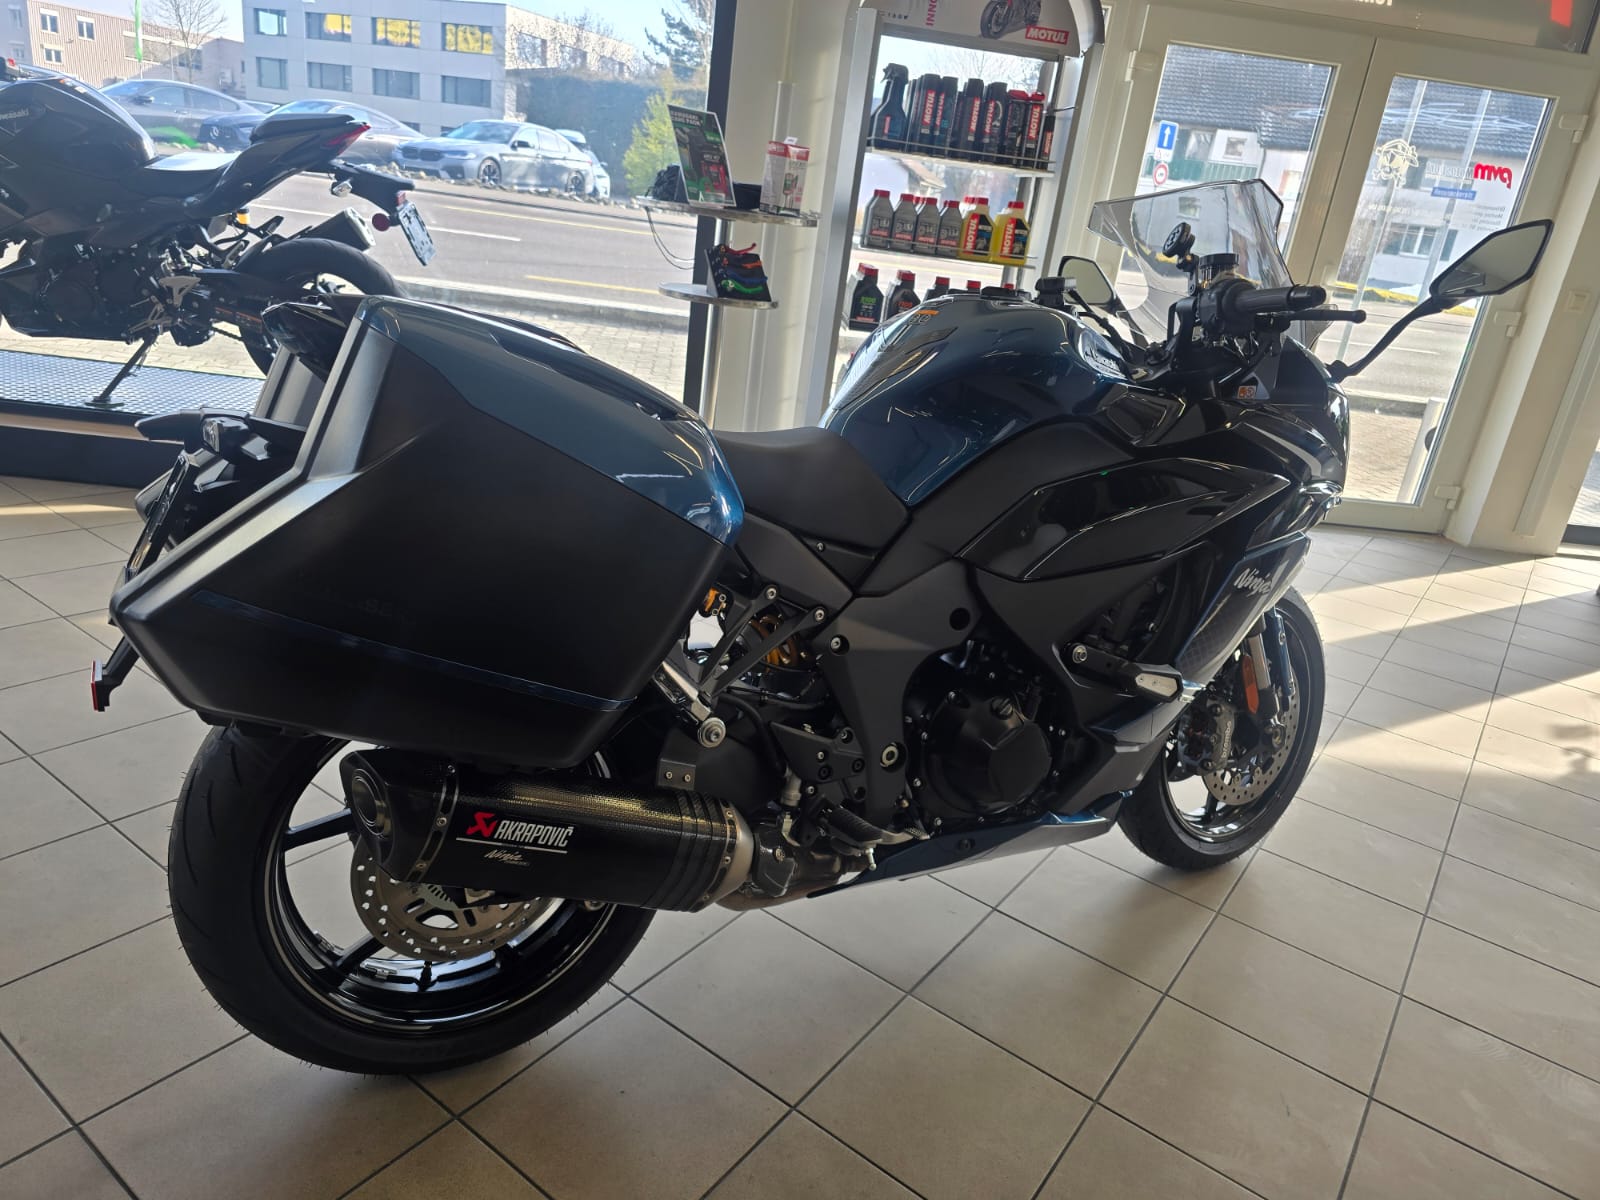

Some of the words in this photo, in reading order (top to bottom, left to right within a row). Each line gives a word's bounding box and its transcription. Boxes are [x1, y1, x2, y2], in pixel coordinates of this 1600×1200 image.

[1027, 27, 1066, 43] MOTUL
[924, 91, 936, 124] MOTUL
[1029, 107, 1040, 139] MOTUL
[965, 219, 978, 251] MOTUL
[1002, 223, 1015, 256] MOTUL
[1233, 567, 1272, 598] Ninja
[1220, 720, 1232, 759] brembo
[484, 849, 523, 861] Ninja
